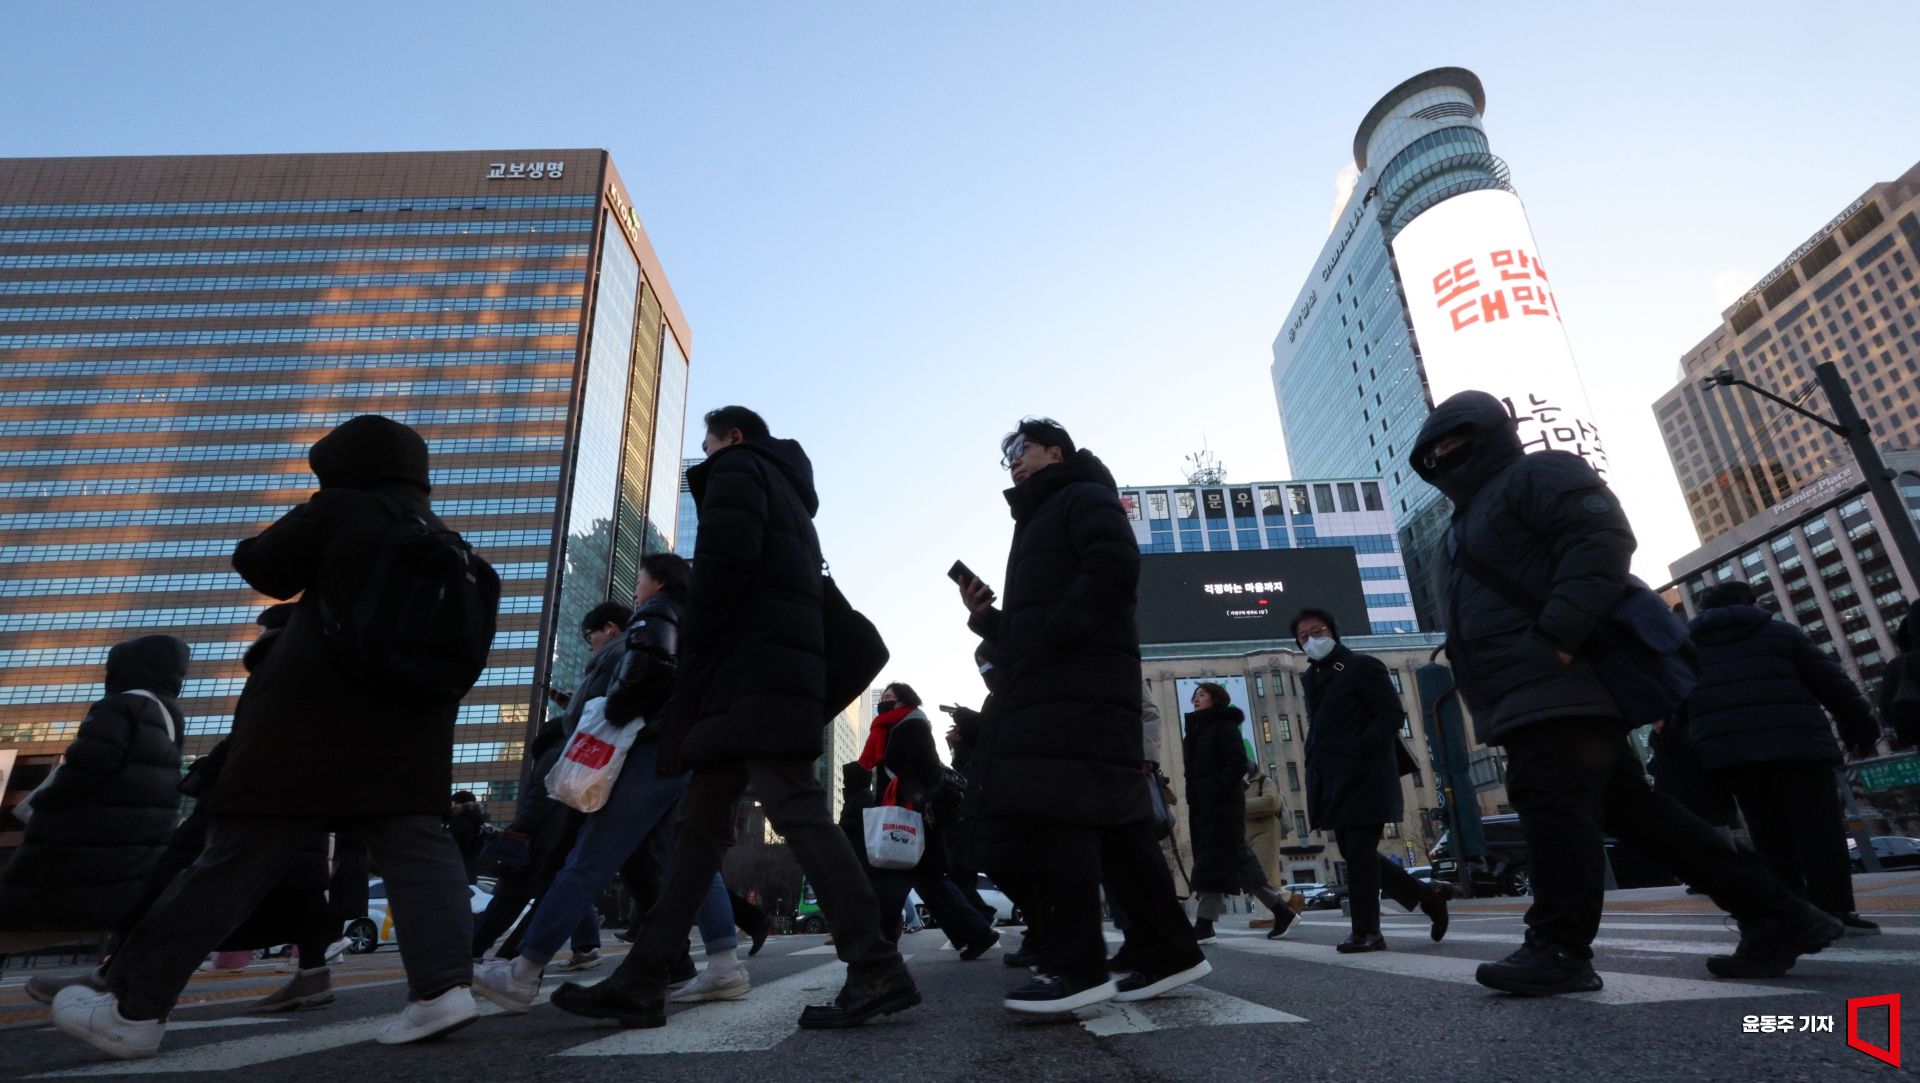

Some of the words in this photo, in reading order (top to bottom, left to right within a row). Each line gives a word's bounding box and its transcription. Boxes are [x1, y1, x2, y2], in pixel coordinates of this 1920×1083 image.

[486, 161, 564, 179] 교보생명
[609, 183, 639, 242] KYOBO
[1749, 269, 1780, 297] SEOUL
[1780, 231, 1824, 272] FINANCE
[1823, 199, 1865, 234] CENTER
[1432, 258, 1480, 308] 또
[1450, 286, 1562, 332] 대만
[1773, 484, 1818, 515] Premier
[1818, 467, 1851, 490] Place
[1204, 583, 1243, 594] 걱정하는
[1244, 581, 1283, 592] 마음까지
